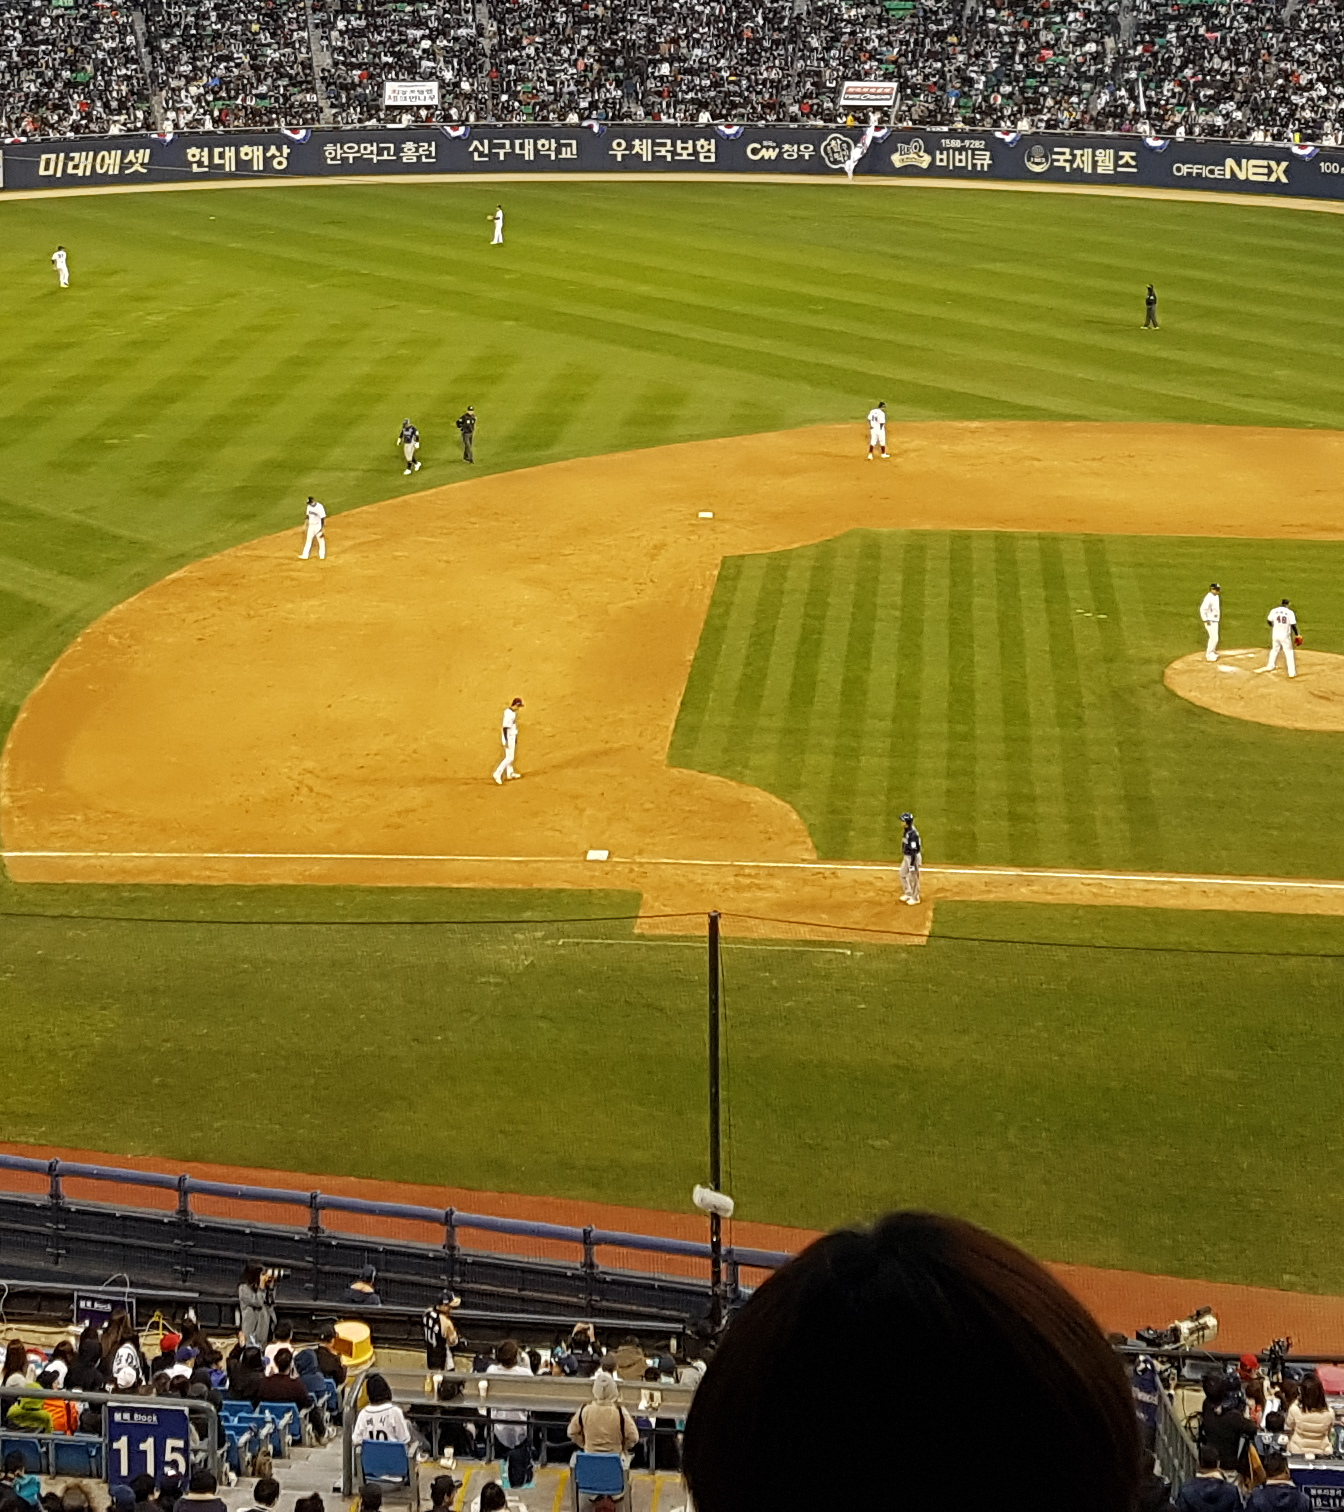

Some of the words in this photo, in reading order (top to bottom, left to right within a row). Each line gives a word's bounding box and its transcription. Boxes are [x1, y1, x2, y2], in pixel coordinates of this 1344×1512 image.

[38, 148, 151, 178] 미래에셋
[186, 142, 291, 173] 현대해상
[323, 141, 397, 165] 한우먹고
[399, 140, 437, 163] 홈런
[468, 138, 578, 163] 신구대학교
[608, 138, 717, 164] 우체국보험
[781, 143, 816, 161] 청우
[936, 149, 993, 172] 비비큐
[133, 1412, 158, 1424] Block
[112, 1435, 187, 1477] 115
